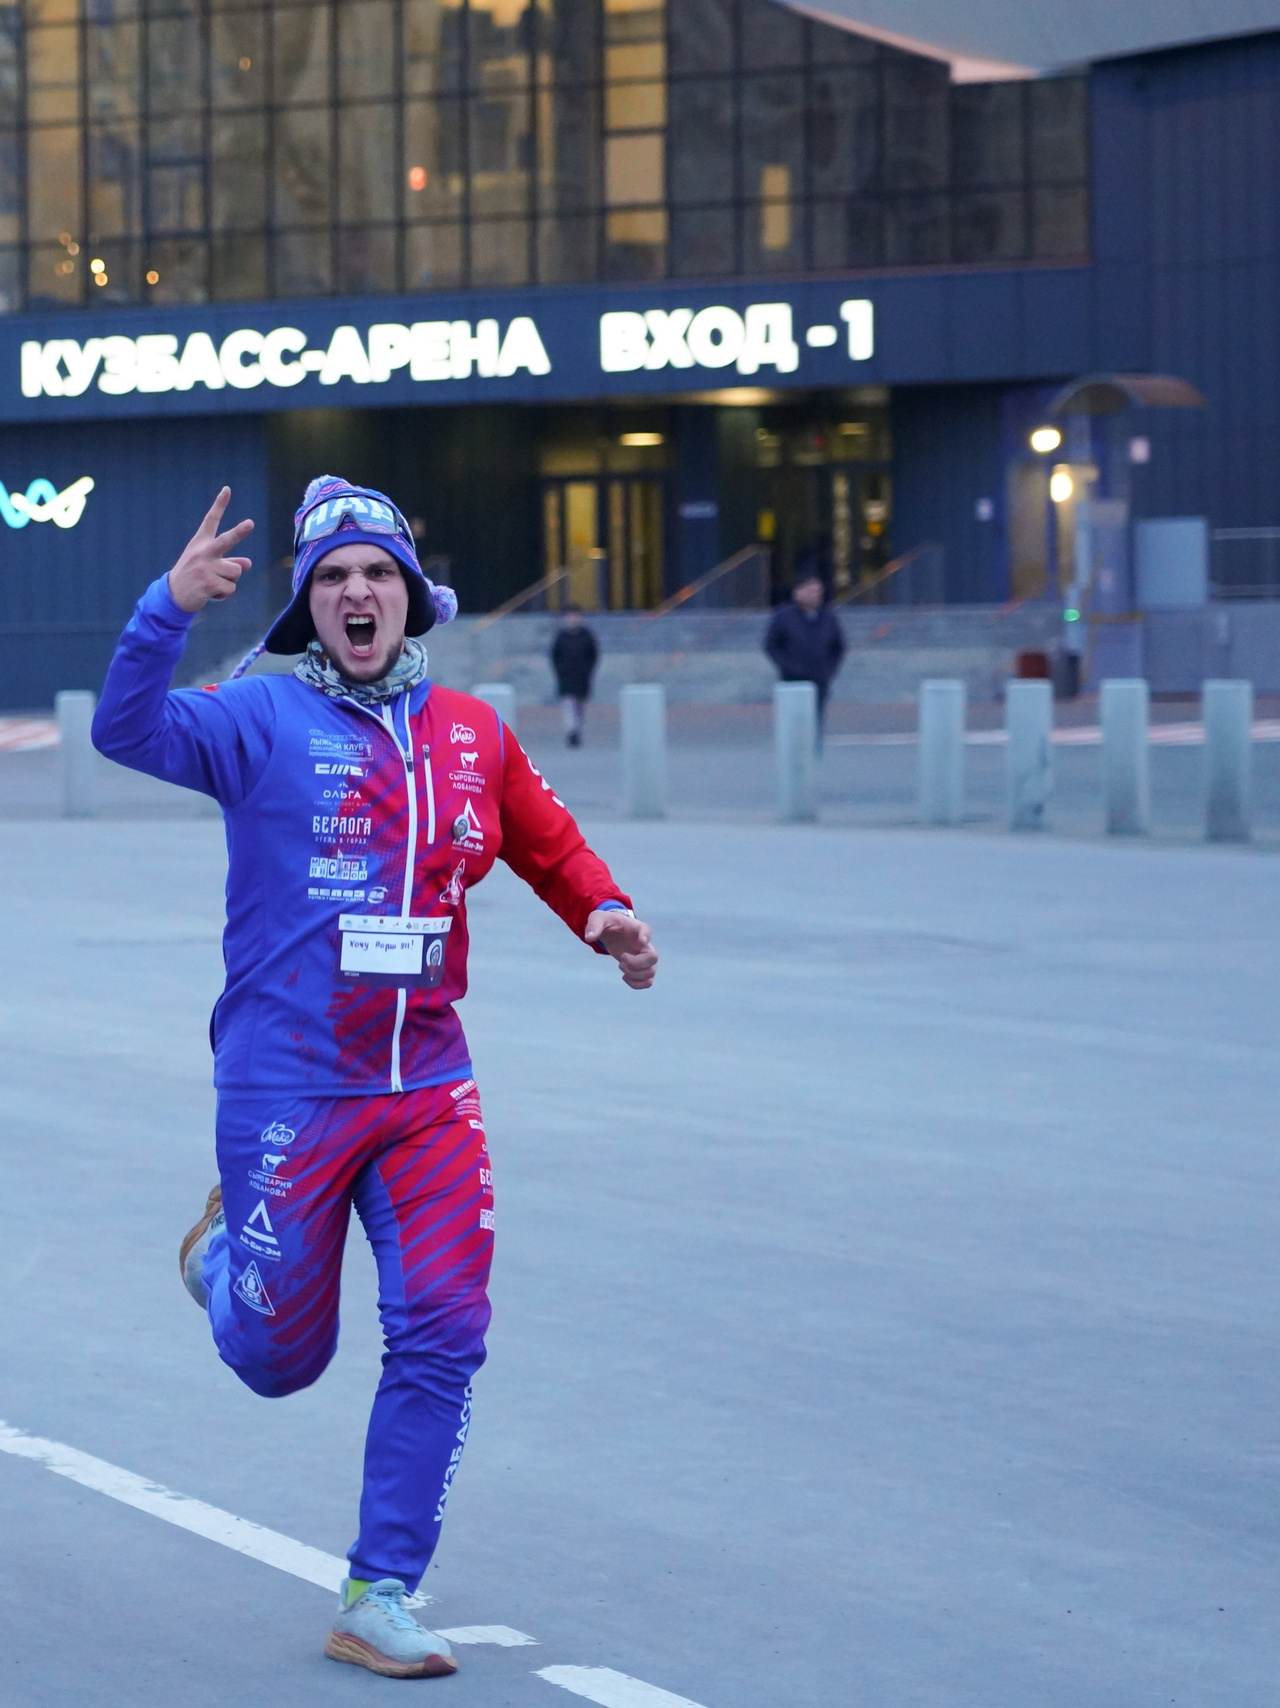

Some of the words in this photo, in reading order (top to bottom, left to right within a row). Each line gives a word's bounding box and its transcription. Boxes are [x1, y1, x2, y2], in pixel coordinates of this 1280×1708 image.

[21, 317, 551, 398] КУЗБАСС-АРЕНА
[344, 743, 364, 751] КЛУБ
[449, 772, 486, 785] СЫРОВАРНЯ
[323, 789, 362, 800] ОЛЬГА
[453, 782, 482, 794] ЛОБАНОВА
[312, 815, 372, 836] БЕРЛОГА
[315, 836, 336, 845] ОТЕЛЬ
[248, 1170, 293, 1190] СЫРОВАРНЯ
[249, 1180, 287, 1197] ЛОБАНОВА
